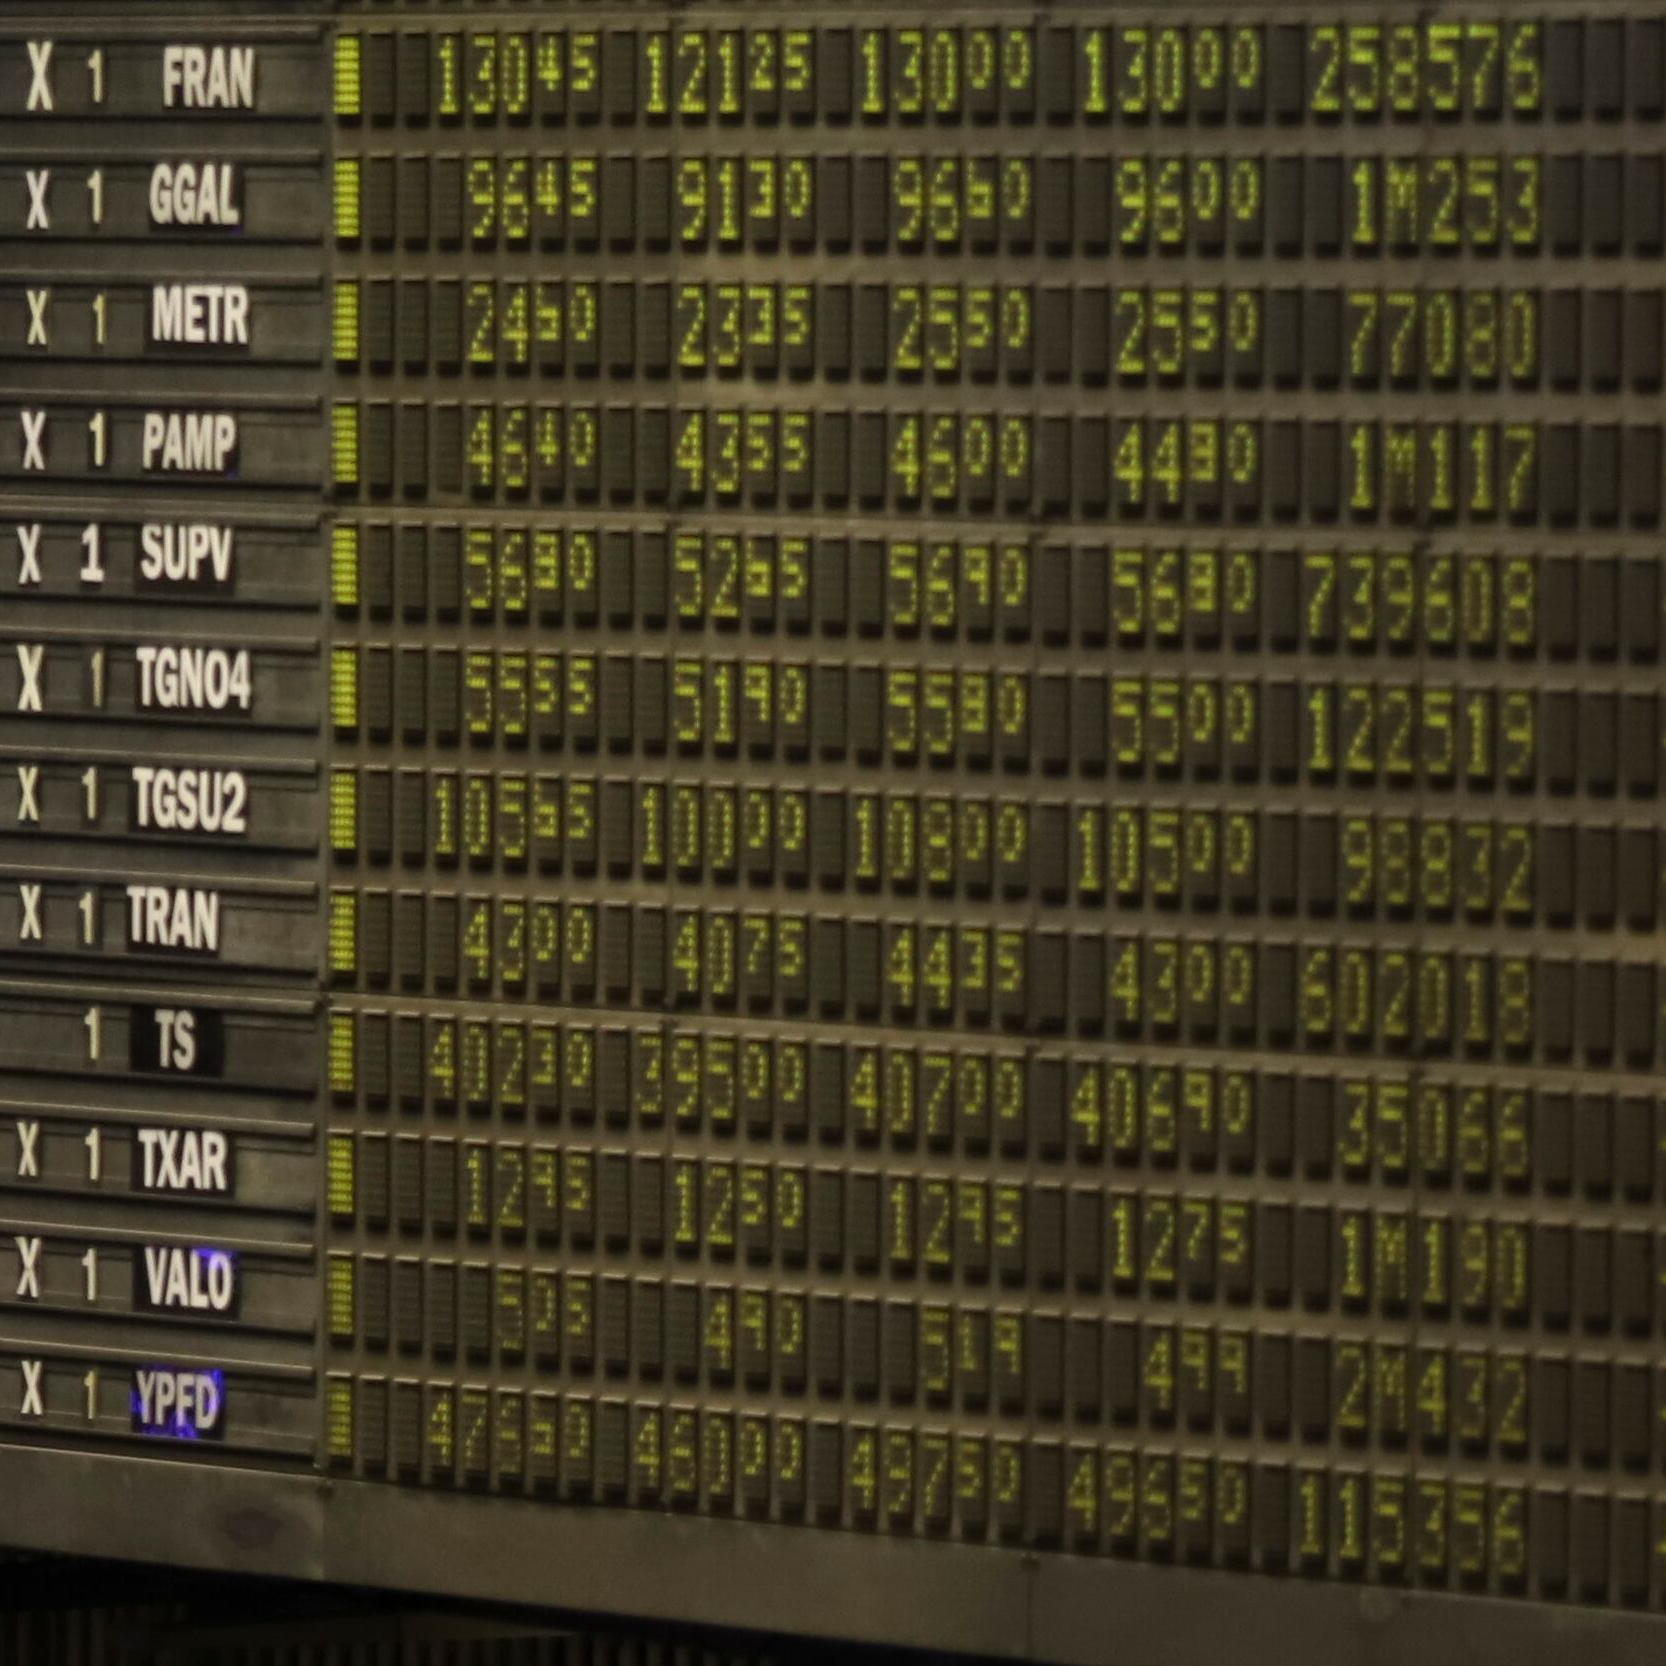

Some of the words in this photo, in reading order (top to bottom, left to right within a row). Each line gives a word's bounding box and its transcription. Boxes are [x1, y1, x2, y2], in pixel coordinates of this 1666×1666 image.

[25, 38, 54, 113] X
[86, 47, 104, 104] 1
[162, 43, 255, 110] FRAN
[24, 167, 50, 231] X
[86, 167, 104, 225] 1
[149, 159, 240, 227] GGAL
[25, 288, 50, 346] X
[91, 292, 106, 345] 1
[152, 283, 250, 345] METR
[19, 408, 47, 472] X
[88, 410, 106, 468] 1
[141, 411, 236, 473] PAMP
[15, 521, 42, 586] X
[79, 521, 106, 584] 1
[140, 522, 233, 583] SUPV
[15, 642, 45, 713] X
[90, 648, 104, 708] 1
[135, 644, 251, 711] TGNO4
[16, 764, 40, 822] X
[80, 764, 98, 821] 1
[131, 764, 248, 834] TGSU2
[18, 883, 43, 941] X
[78, 889, 95, 946] 1
[126, 884, 220, 952] TRAN
[83, 1006, 101, 1061] 1
[155, 1007, 197, 1072] TS
[15, 1118, 40, 1178] X
[83, 1126, 101, 1182] 1
[137, 1126, 229, 1192] TXAR
[14, 1234, 43, 1299] X
[80, 1246, 98, 1302] 1
[143, 1244, 235, 1312] VALO
[20, 1358, 44, 1417] X
[83, 1369, 97, 1421] 1
[136, 1368, 220, 1430] YPFD
